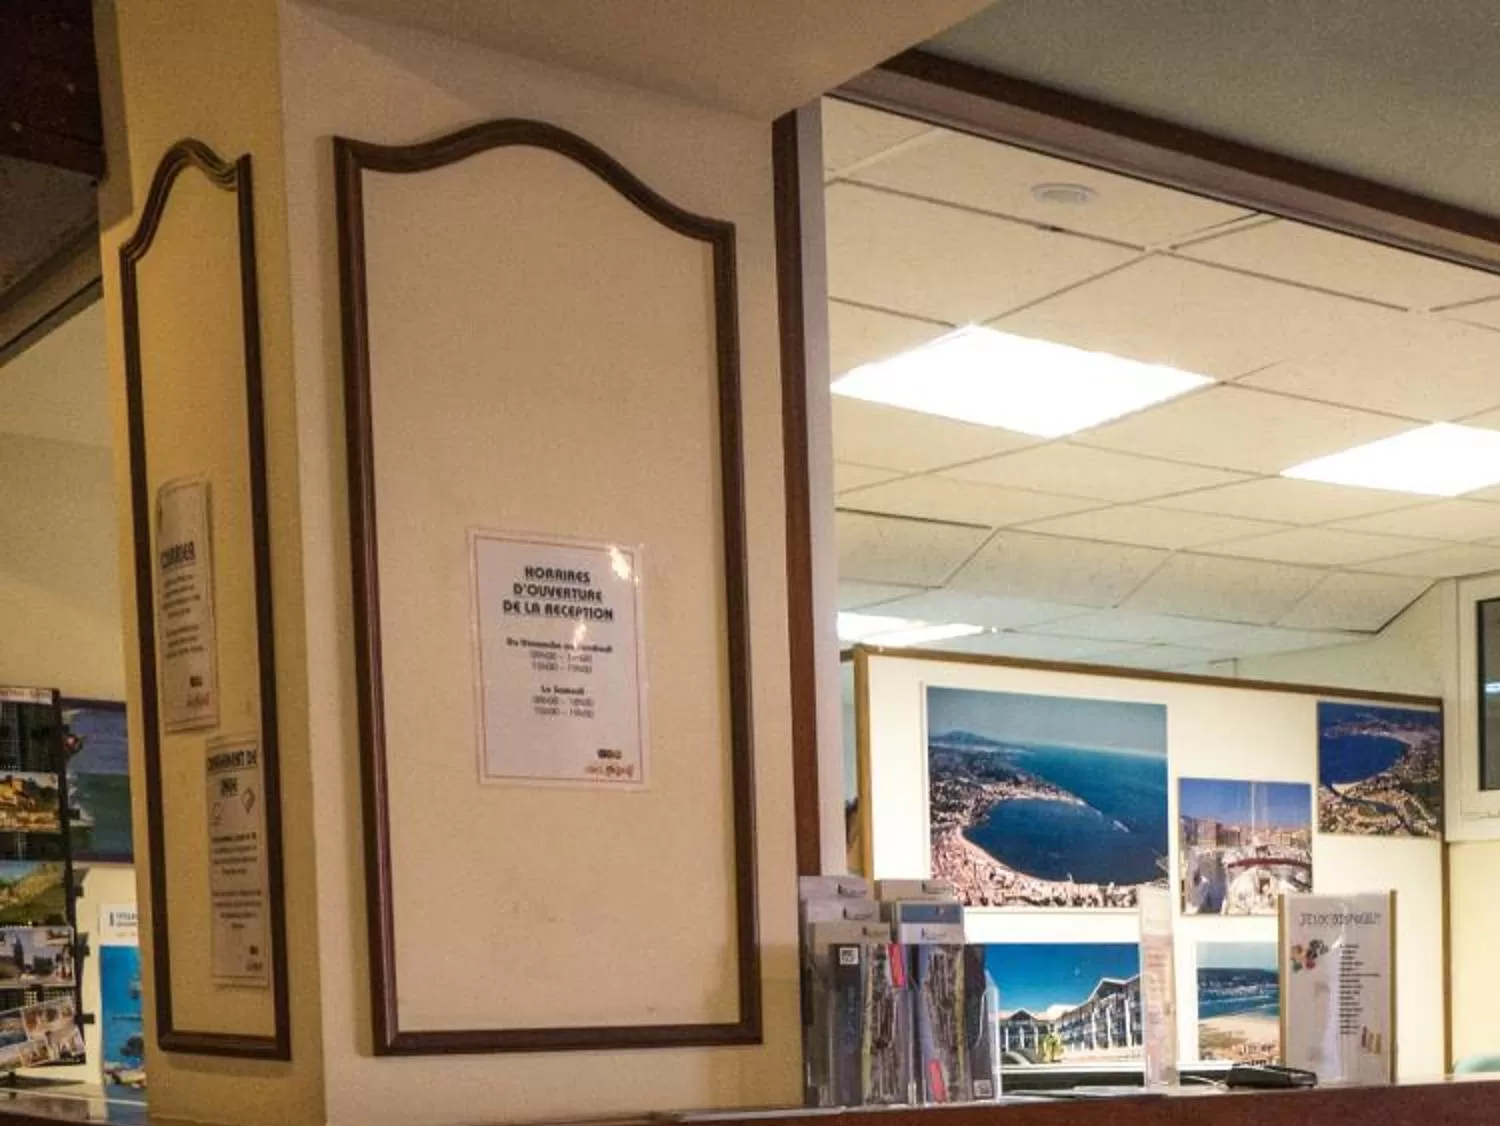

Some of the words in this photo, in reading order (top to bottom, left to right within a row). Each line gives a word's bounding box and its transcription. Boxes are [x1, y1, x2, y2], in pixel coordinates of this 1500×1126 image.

[525, 566, 590, 584] HORAIRES
[513, 582, 602, 603] D'OUVERTURE
[503, 600, 520, 614] DE
[525, 601, 541, 615] LA
[545, 603, 613, 621] RECEPTION
